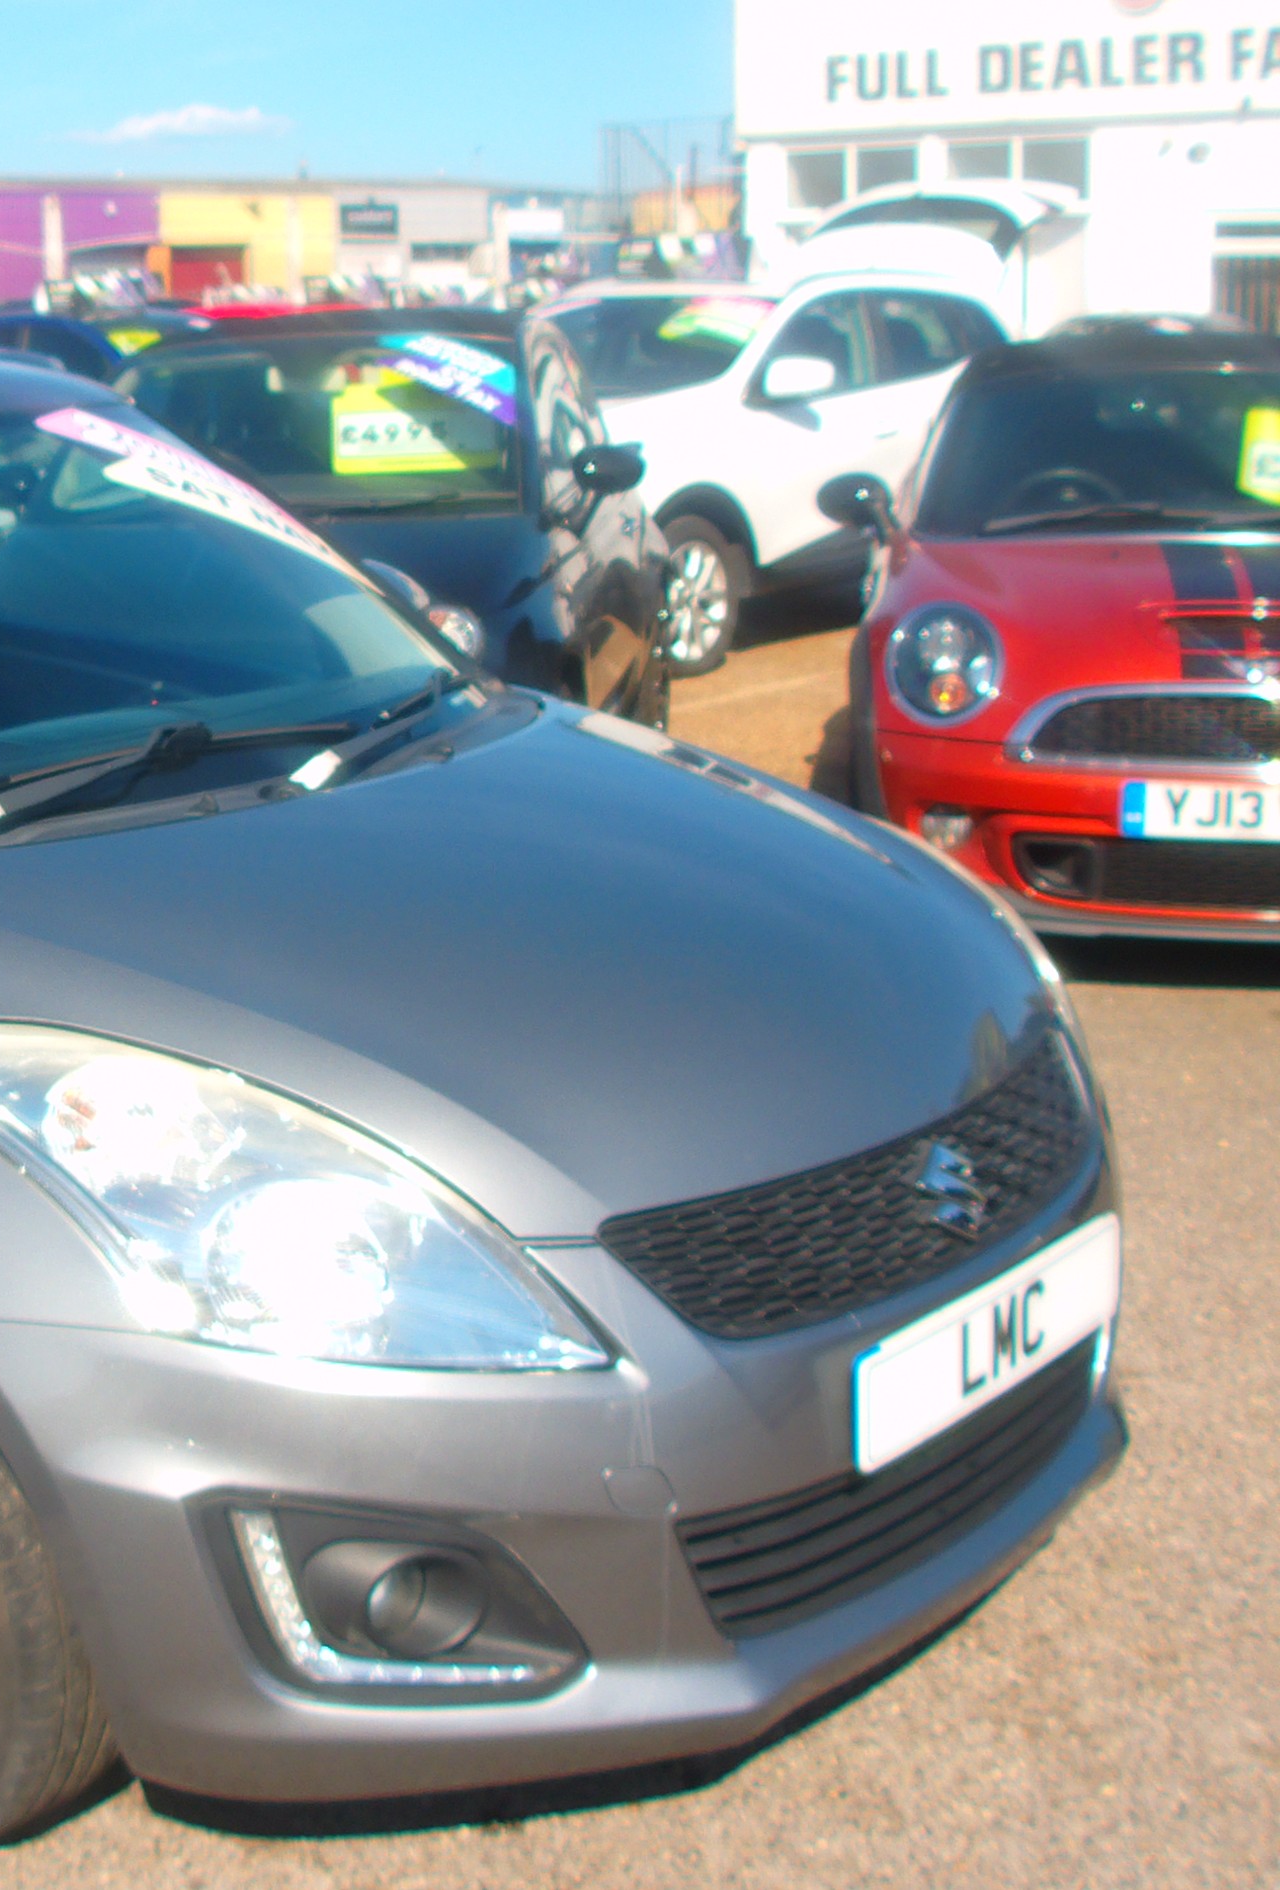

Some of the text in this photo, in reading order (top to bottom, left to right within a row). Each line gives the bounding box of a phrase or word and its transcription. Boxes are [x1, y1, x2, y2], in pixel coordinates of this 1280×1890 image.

[826, 49, 950, 103] FULL
[978, 31, 1206, 94] DEALER
[145, 465, 231, 509] SAT
[1166, 788, 1266, 829] YJ13
[961, 1278, 1046, 1398] LMC
